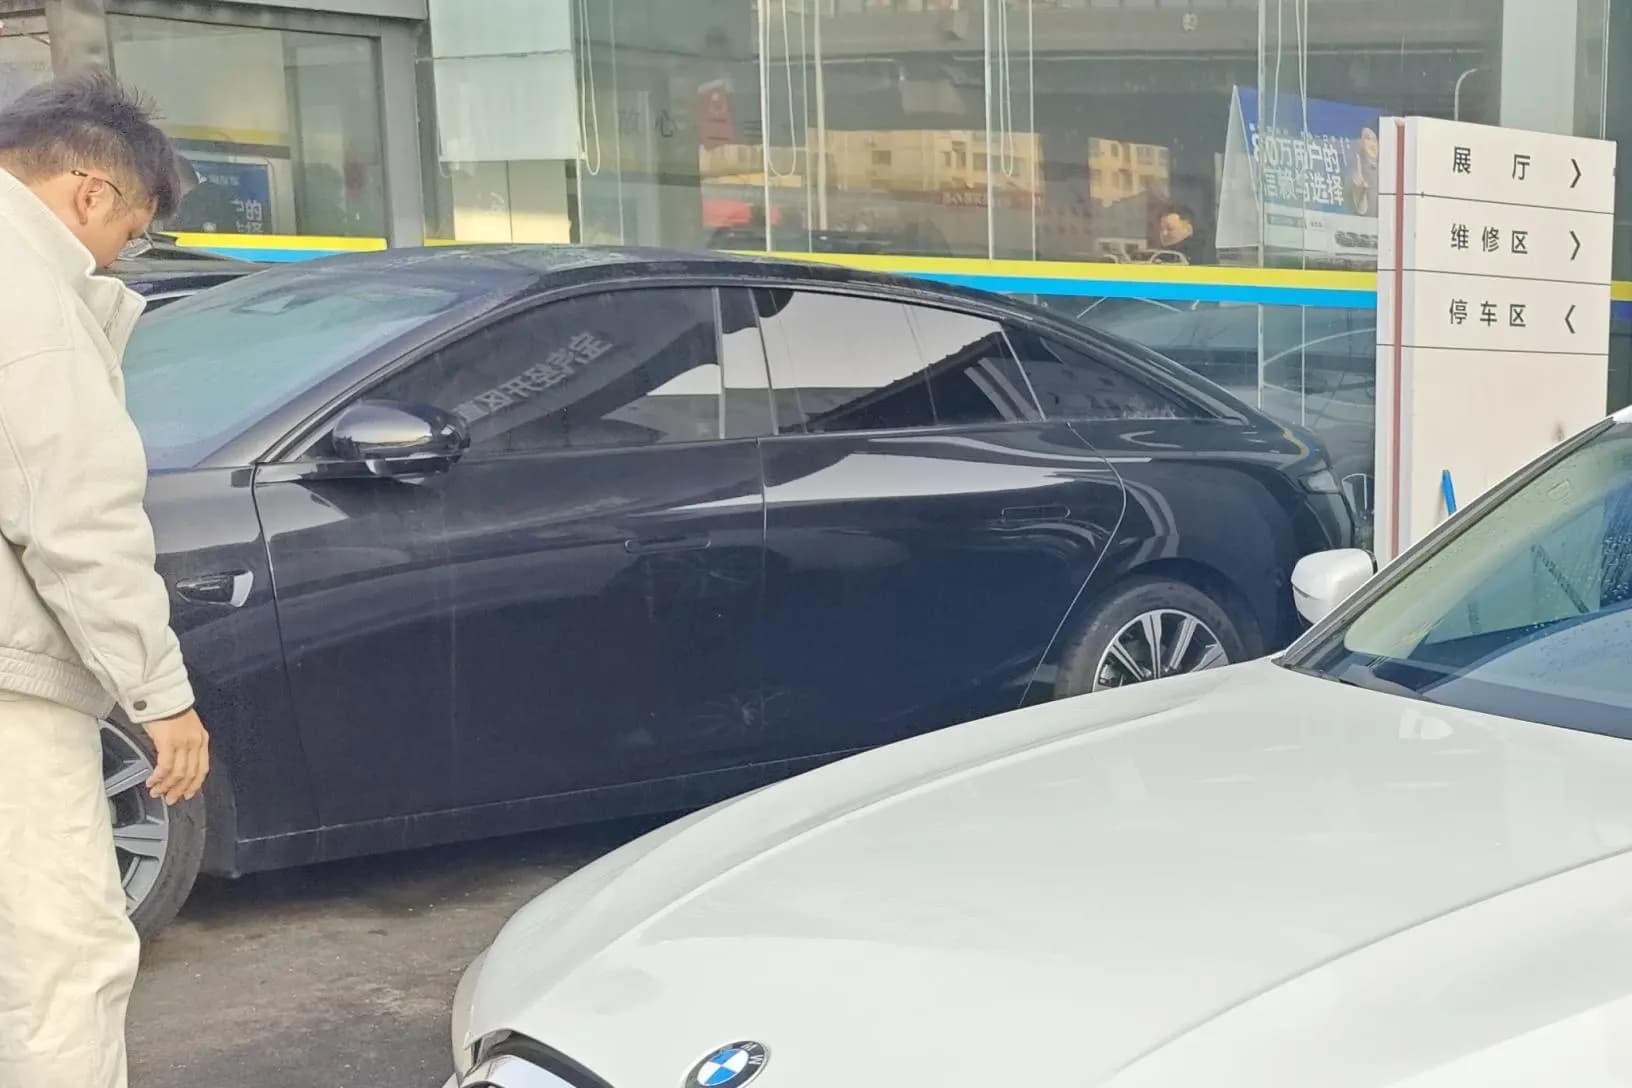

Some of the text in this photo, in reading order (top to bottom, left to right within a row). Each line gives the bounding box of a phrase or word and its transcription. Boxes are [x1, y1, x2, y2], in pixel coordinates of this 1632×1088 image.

[1452, 146, 1531, 181] 展厅
[1450, 223, 1528, 254] 维修区
[1449, 299, 1527, 328] 停车区
